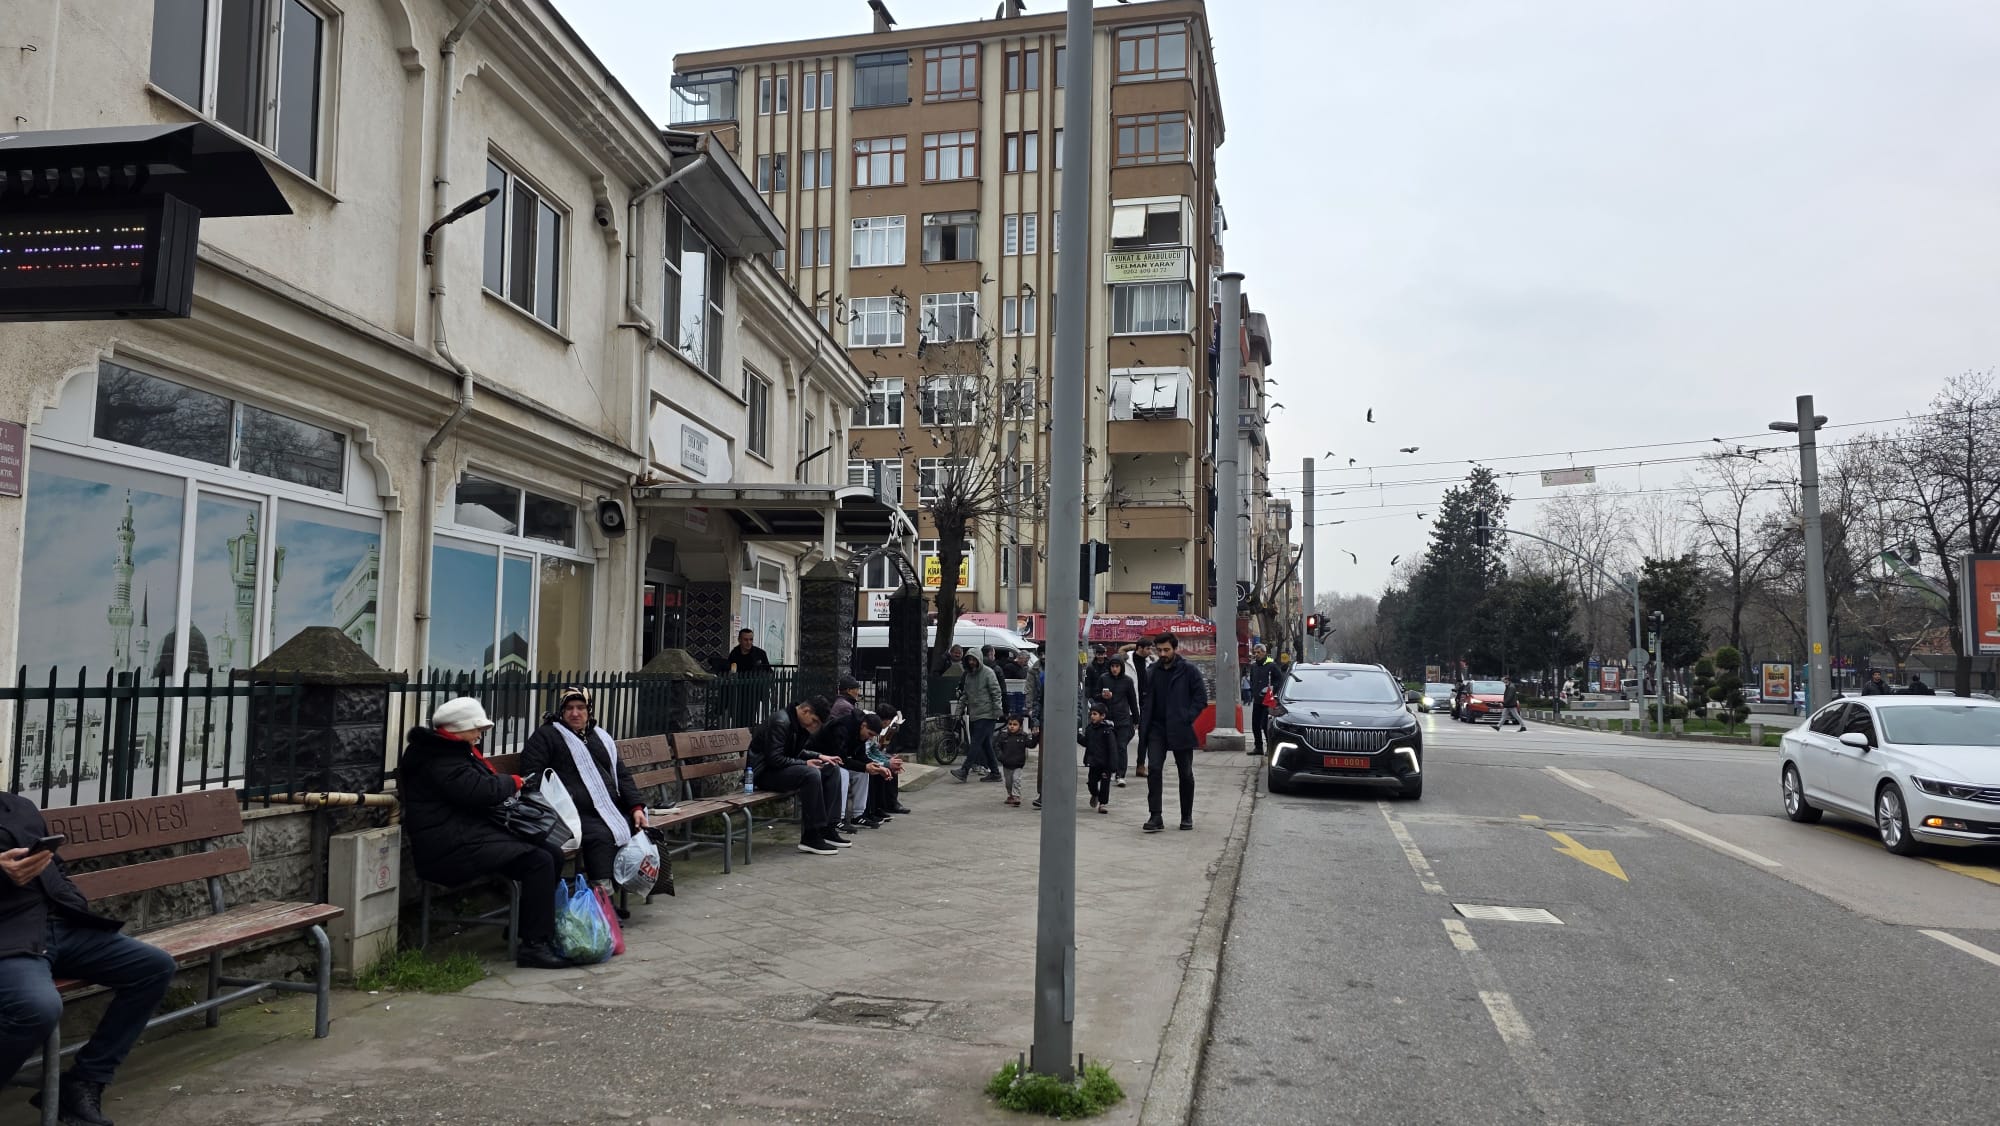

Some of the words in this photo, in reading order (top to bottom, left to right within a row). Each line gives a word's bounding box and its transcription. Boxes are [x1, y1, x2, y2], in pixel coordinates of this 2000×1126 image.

[1110, 254, 1134, 262] AVUKAT
[1115, 262, 1147, 270] SELMAN
[1150, 261, 1175, 269] YARAY
[1170, 625, 1204, 635] Simitçi
[51, 799, 189, 846] BELEDİYESİ
